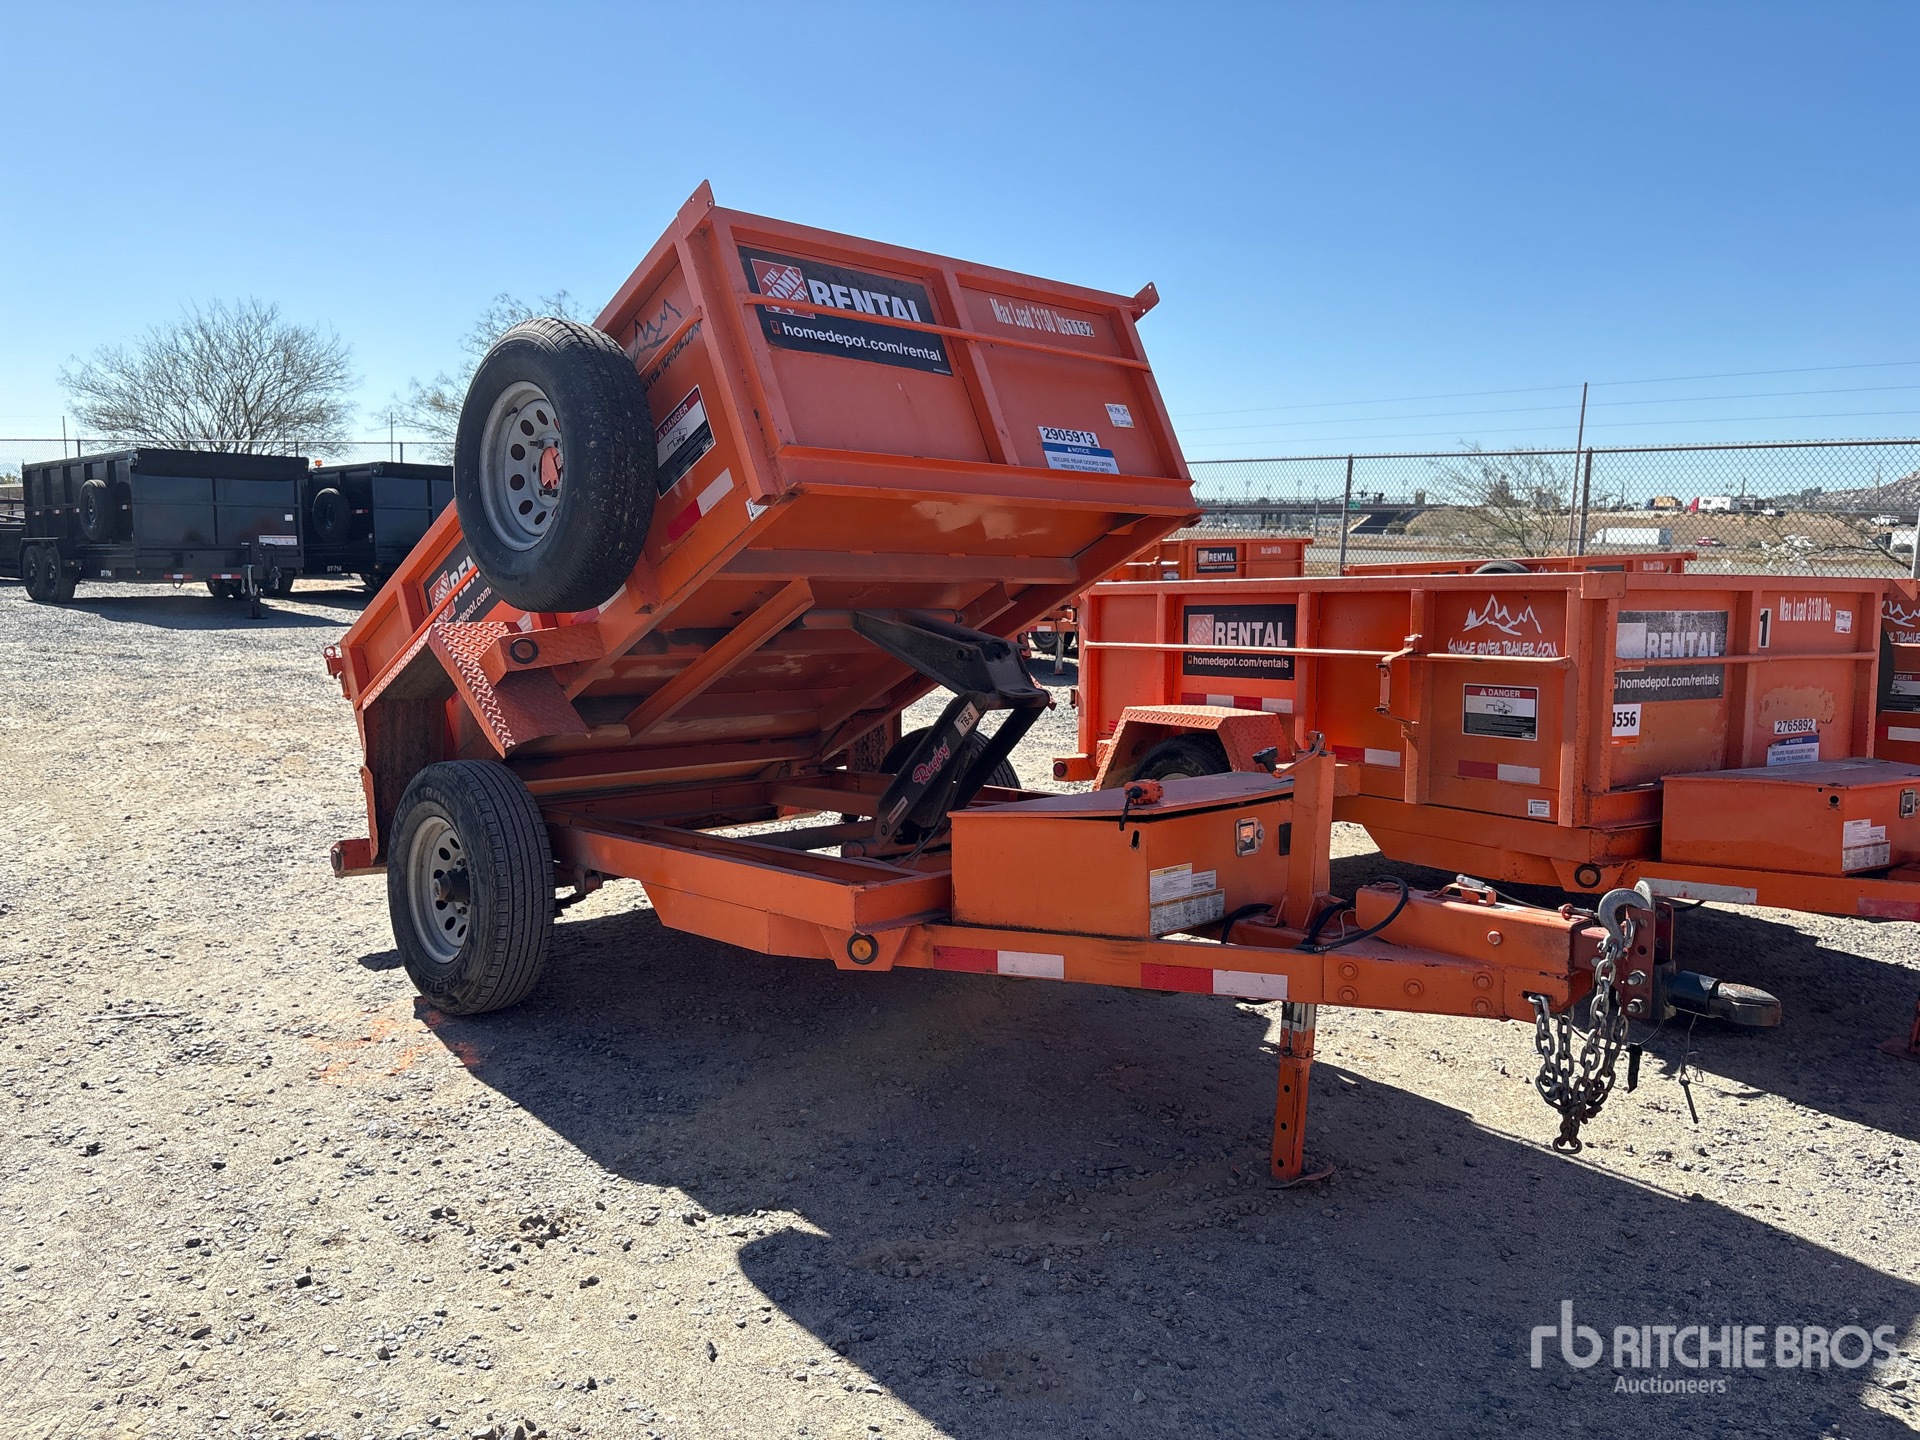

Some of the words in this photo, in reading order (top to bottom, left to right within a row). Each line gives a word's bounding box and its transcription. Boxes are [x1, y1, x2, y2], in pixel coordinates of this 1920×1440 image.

[762, 267, 780, 287] THE
[807, 279, 922, 323] RENTAL
[988, 298, 1014, 325] Max
[1009, 302, 1035, 328] Load
[1031, 307, 1056, 333] 3130
[782, 322, 942, 362] homedepot.com/rental
[664, 403, 689, 434] DANGER
[1043, 427, 1095, 445] 2905913
[1071, 447, 1091, 455] NOTICE
[1208, 552, 1235, 563] RENTAL
[449, 555, 480, 602] REN
[1779, 596, 1792, 621] Max
[1793, 596, 1807, 621] Load
[1807, 597, 1822, 621] 3130
[1823, 597, 1831, 622] lbs
[1214, 621, 1288, 647] RENTAL
[1448, 638, 1476, 654] SNAKE
[1477, 639, 1501, 655] RIVER
[1502, 640, 1559, 657] TRAILER.COM
[1647, 631, 1720, 658] RENTAL
[1193, 656, 1289, 669] homedepot.com/rentals
[1620, 674, 1719, 690] homedepot.com/rentals
[1488, 689, 1521, 698] DANGER
[960, 711, 974, 729] TB-8
[1776, 719, 1814, 733] 2765892
[912, 744, 951, 785] Rugby
